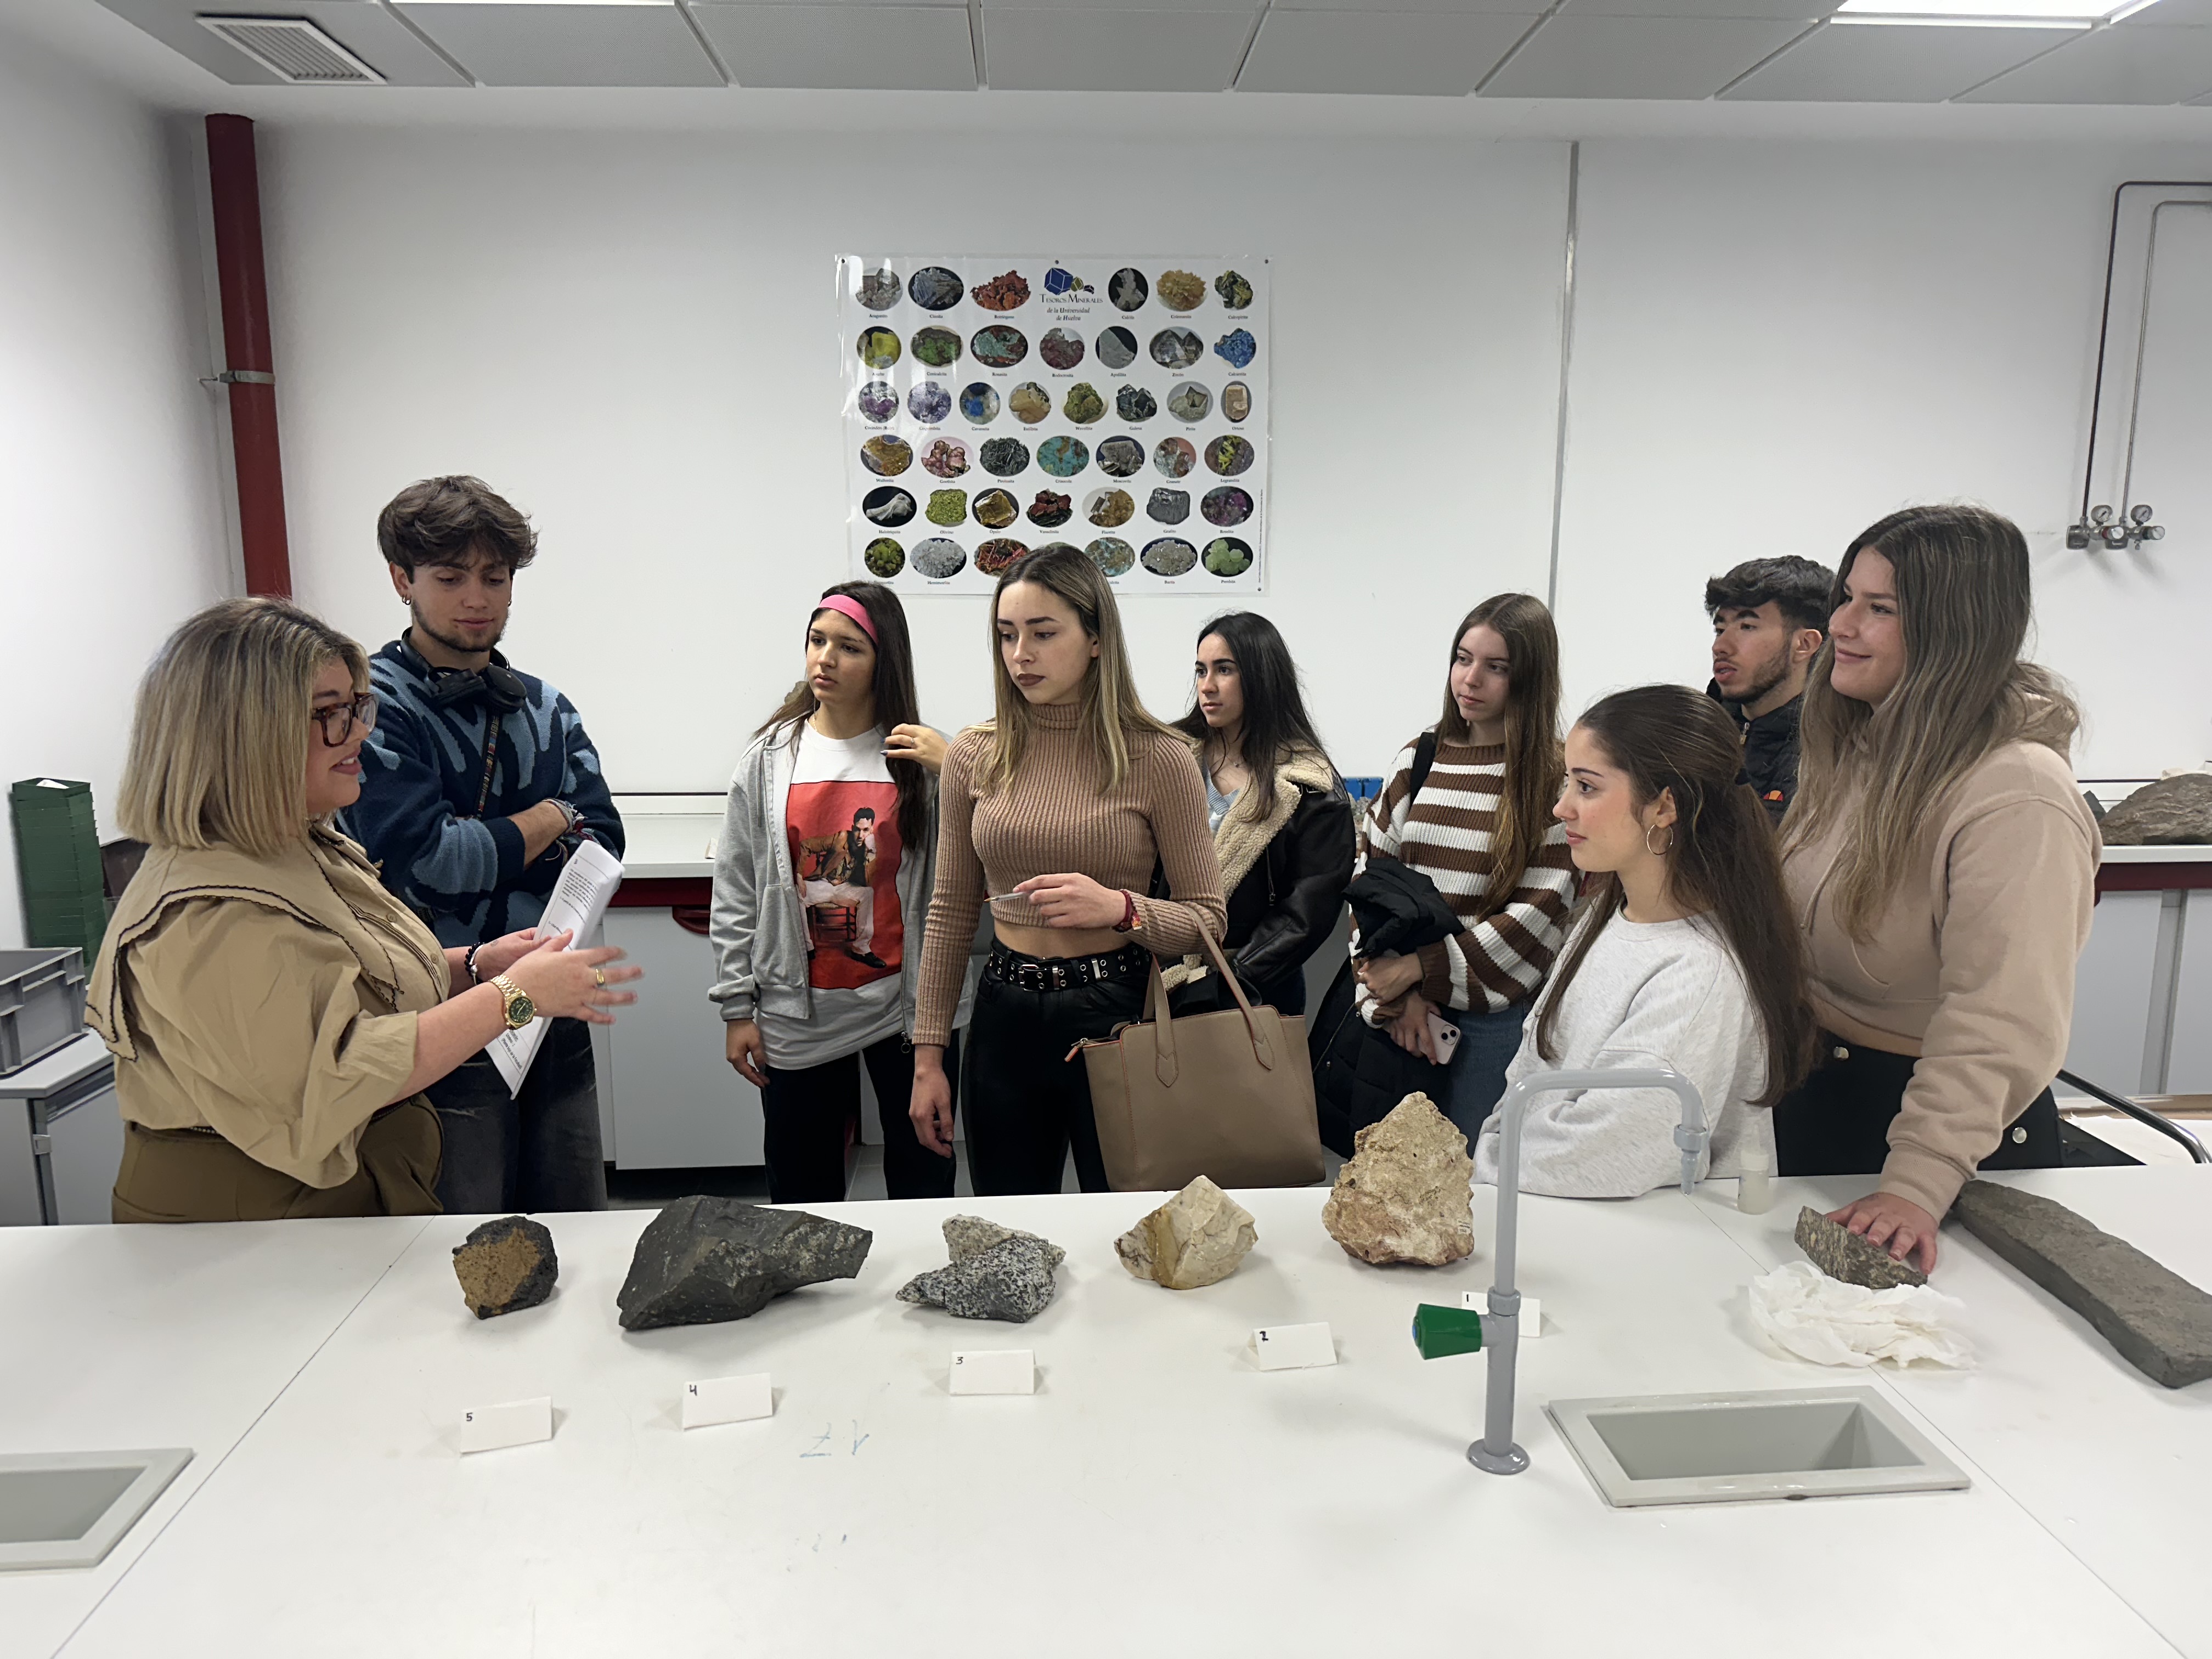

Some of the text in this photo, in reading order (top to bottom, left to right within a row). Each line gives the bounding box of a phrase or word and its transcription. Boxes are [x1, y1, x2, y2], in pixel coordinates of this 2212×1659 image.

[1068, 294, 1103, 303] MINERALES
[1466, 1293, 1470, 1302] 1
[1259, 1330, 1269, 1342] 2
[956, 1356, 964, 1365] 3
[689, 1384, 698, 1396] 4
[466, 1413, 473, 1422] 5
